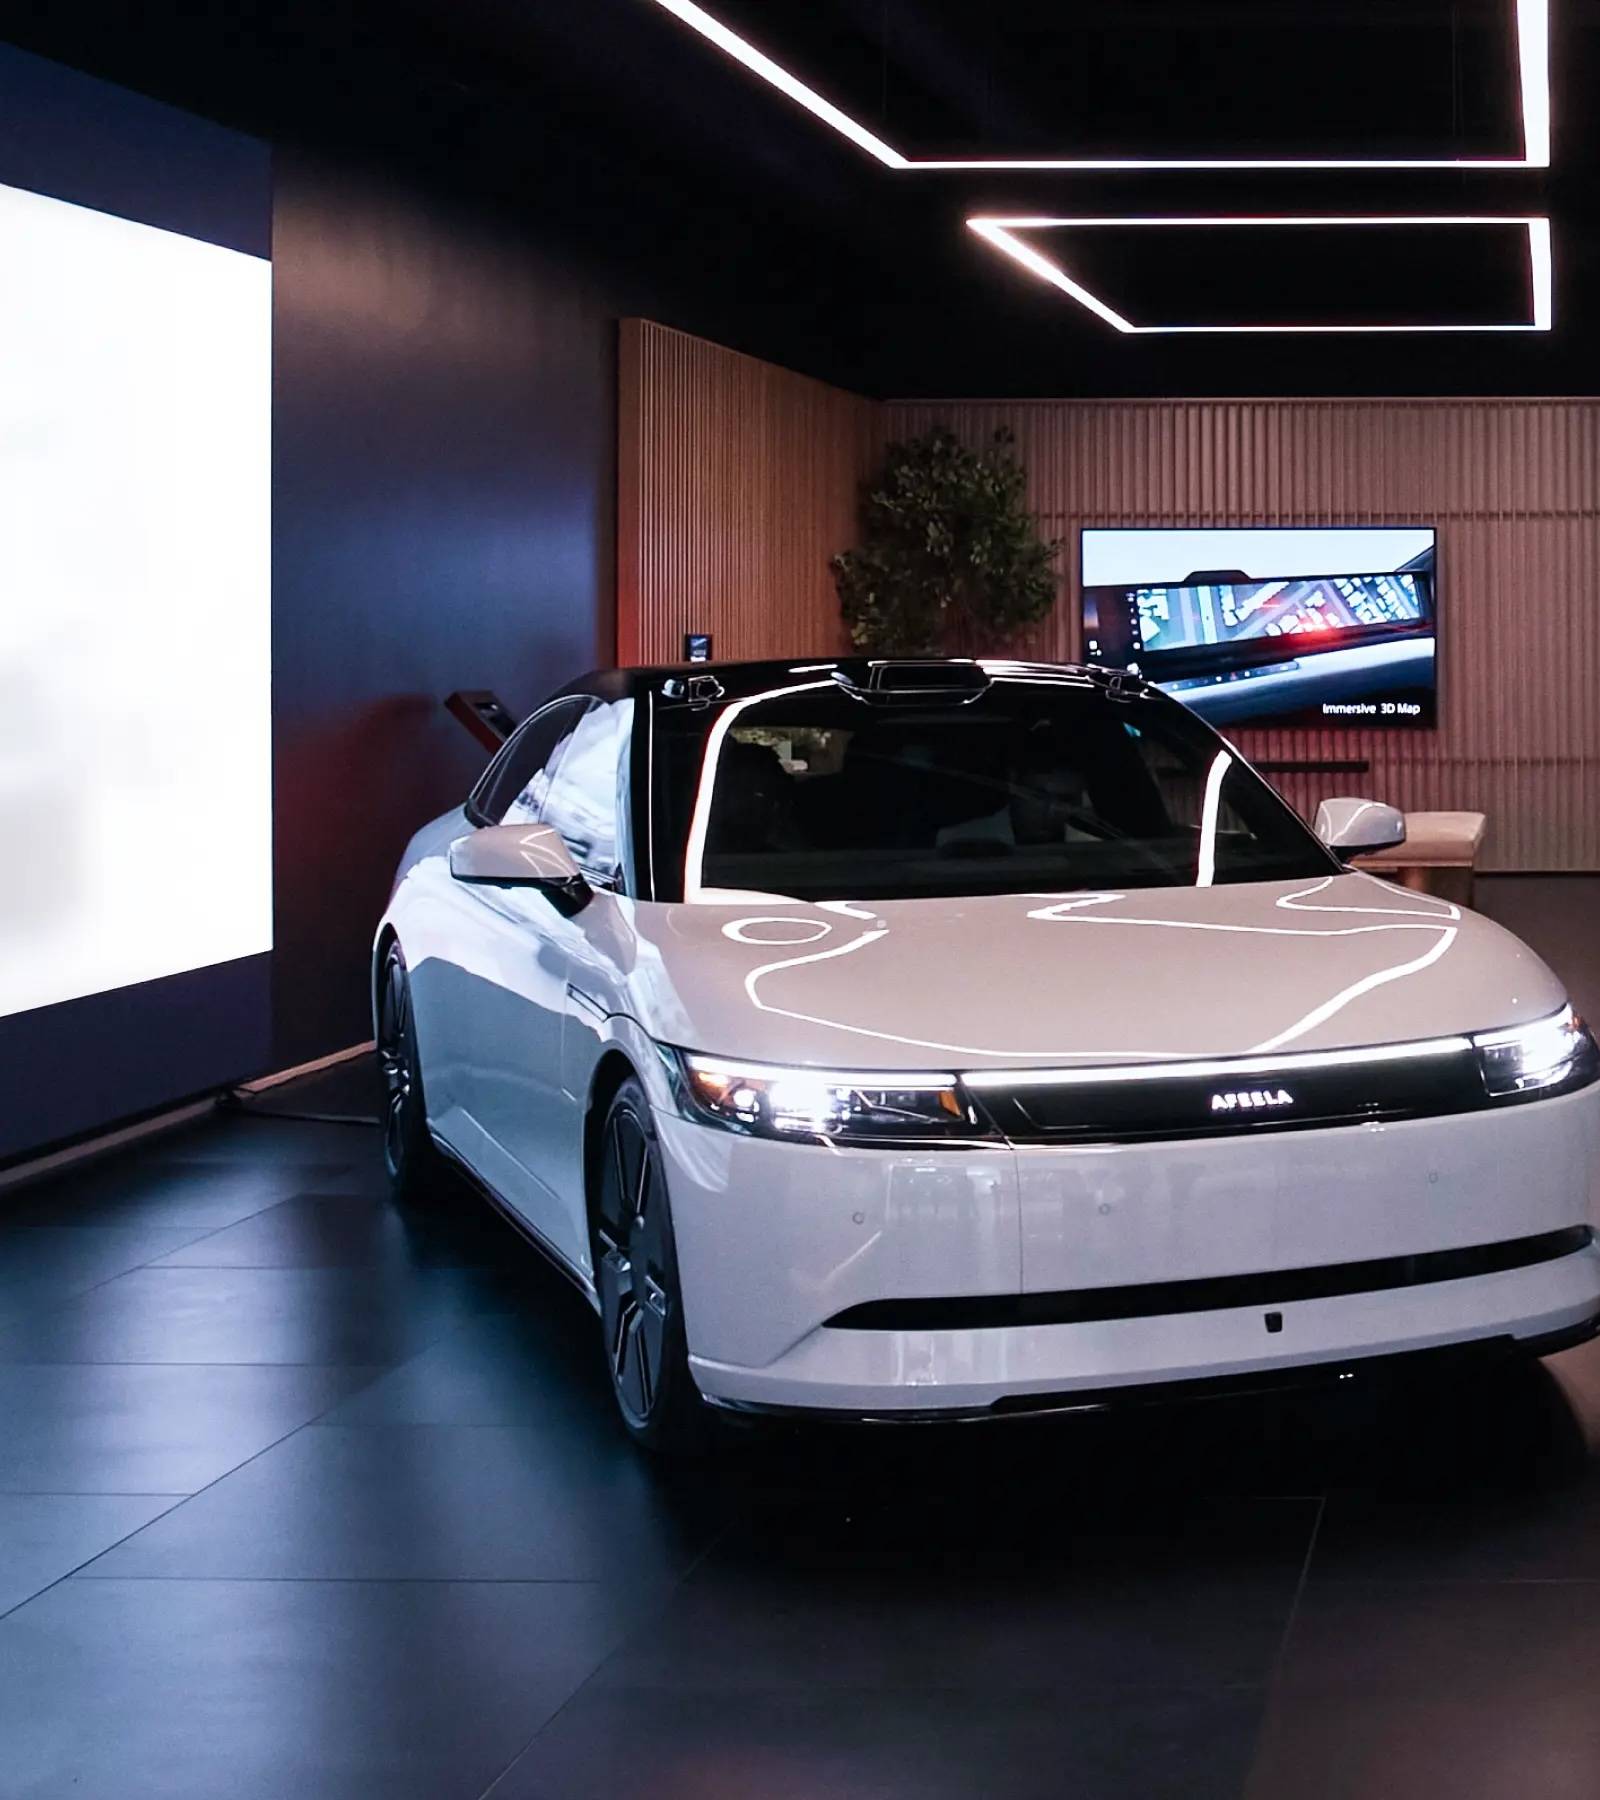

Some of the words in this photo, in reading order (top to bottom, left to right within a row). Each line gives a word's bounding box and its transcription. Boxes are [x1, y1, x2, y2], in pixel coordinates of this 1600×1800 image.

[1322, 703, 1376, 714] Immersive
[1381, 703, 1395, 714] 3D
[1397, 703, 1420, 715] Map
[1211, 1089, 1294, 1110] AFEELA
